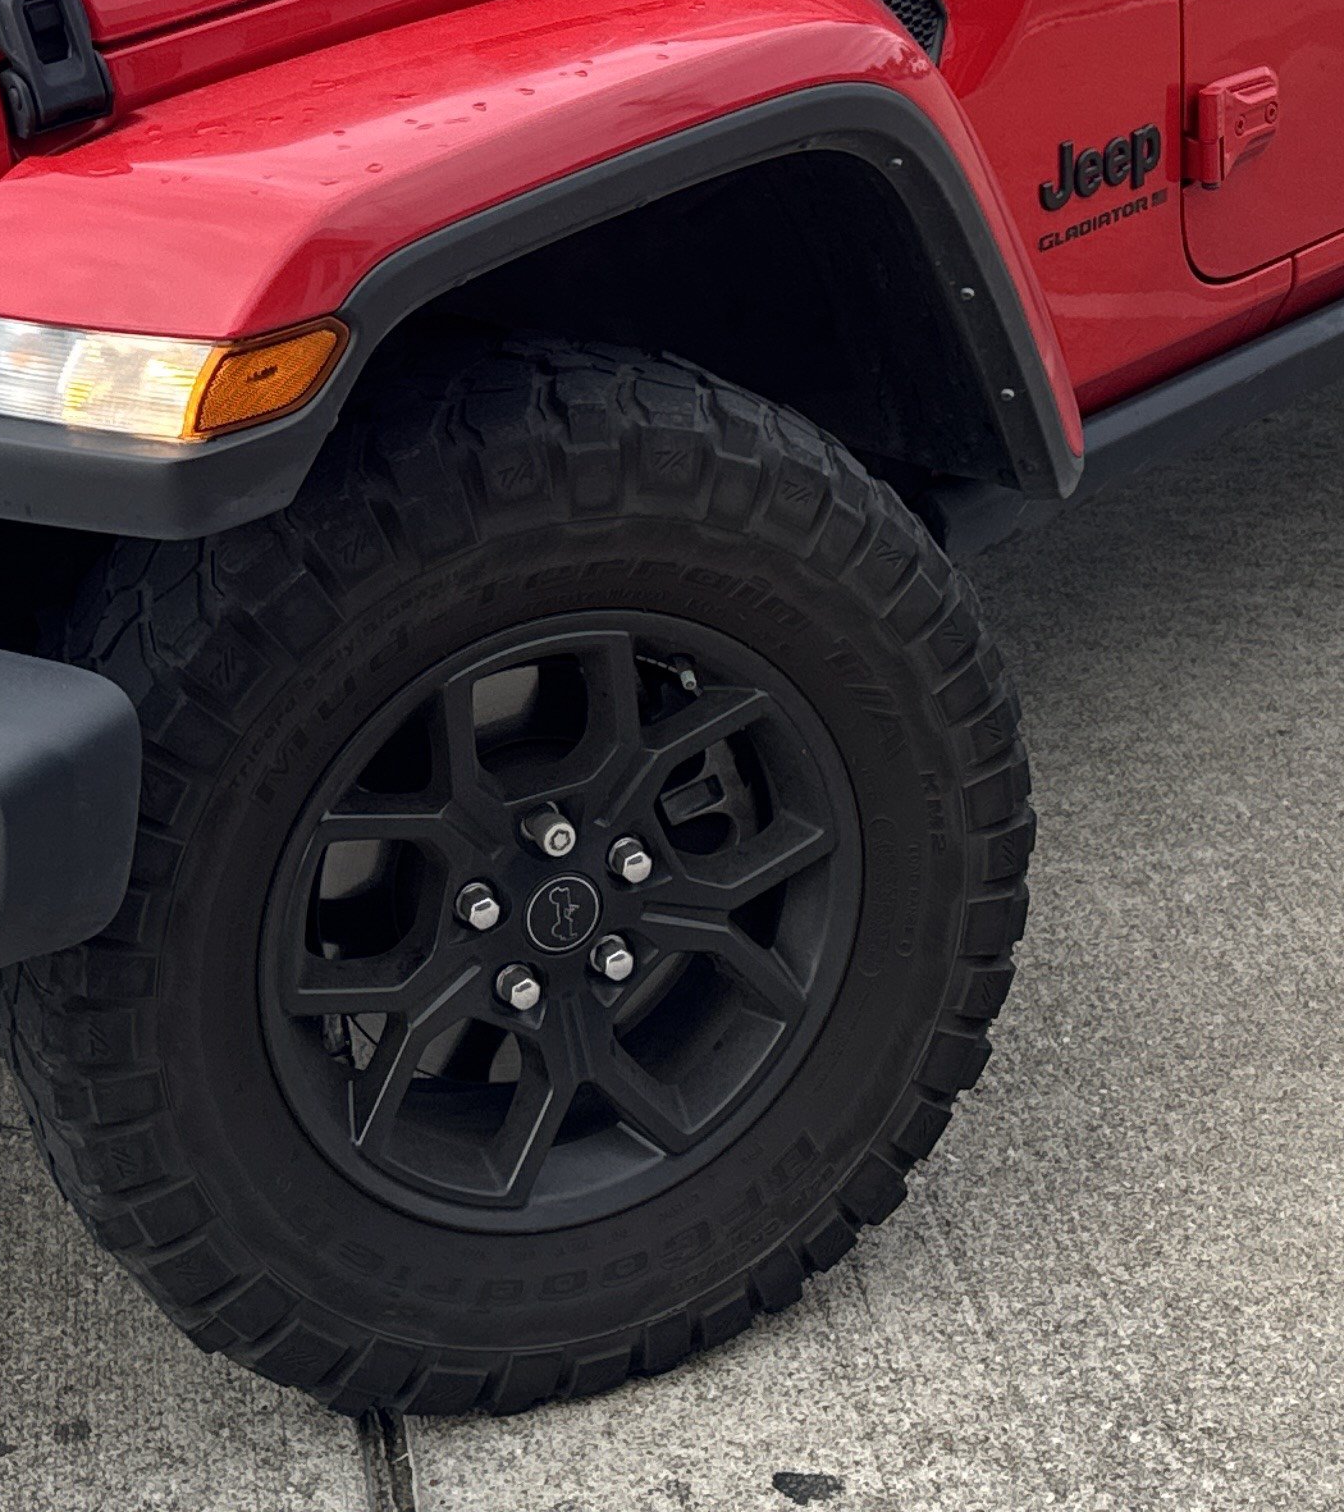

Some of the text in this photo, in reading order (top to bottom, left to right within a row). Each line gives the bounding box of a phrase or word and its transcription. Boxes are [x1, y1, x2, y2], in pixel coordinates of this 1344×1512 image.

[1039, 123, 1162, 212] Jeep
[1038, 196, 1148, 254] GLADIATOR
[917, 770, 949, 858] KM2
